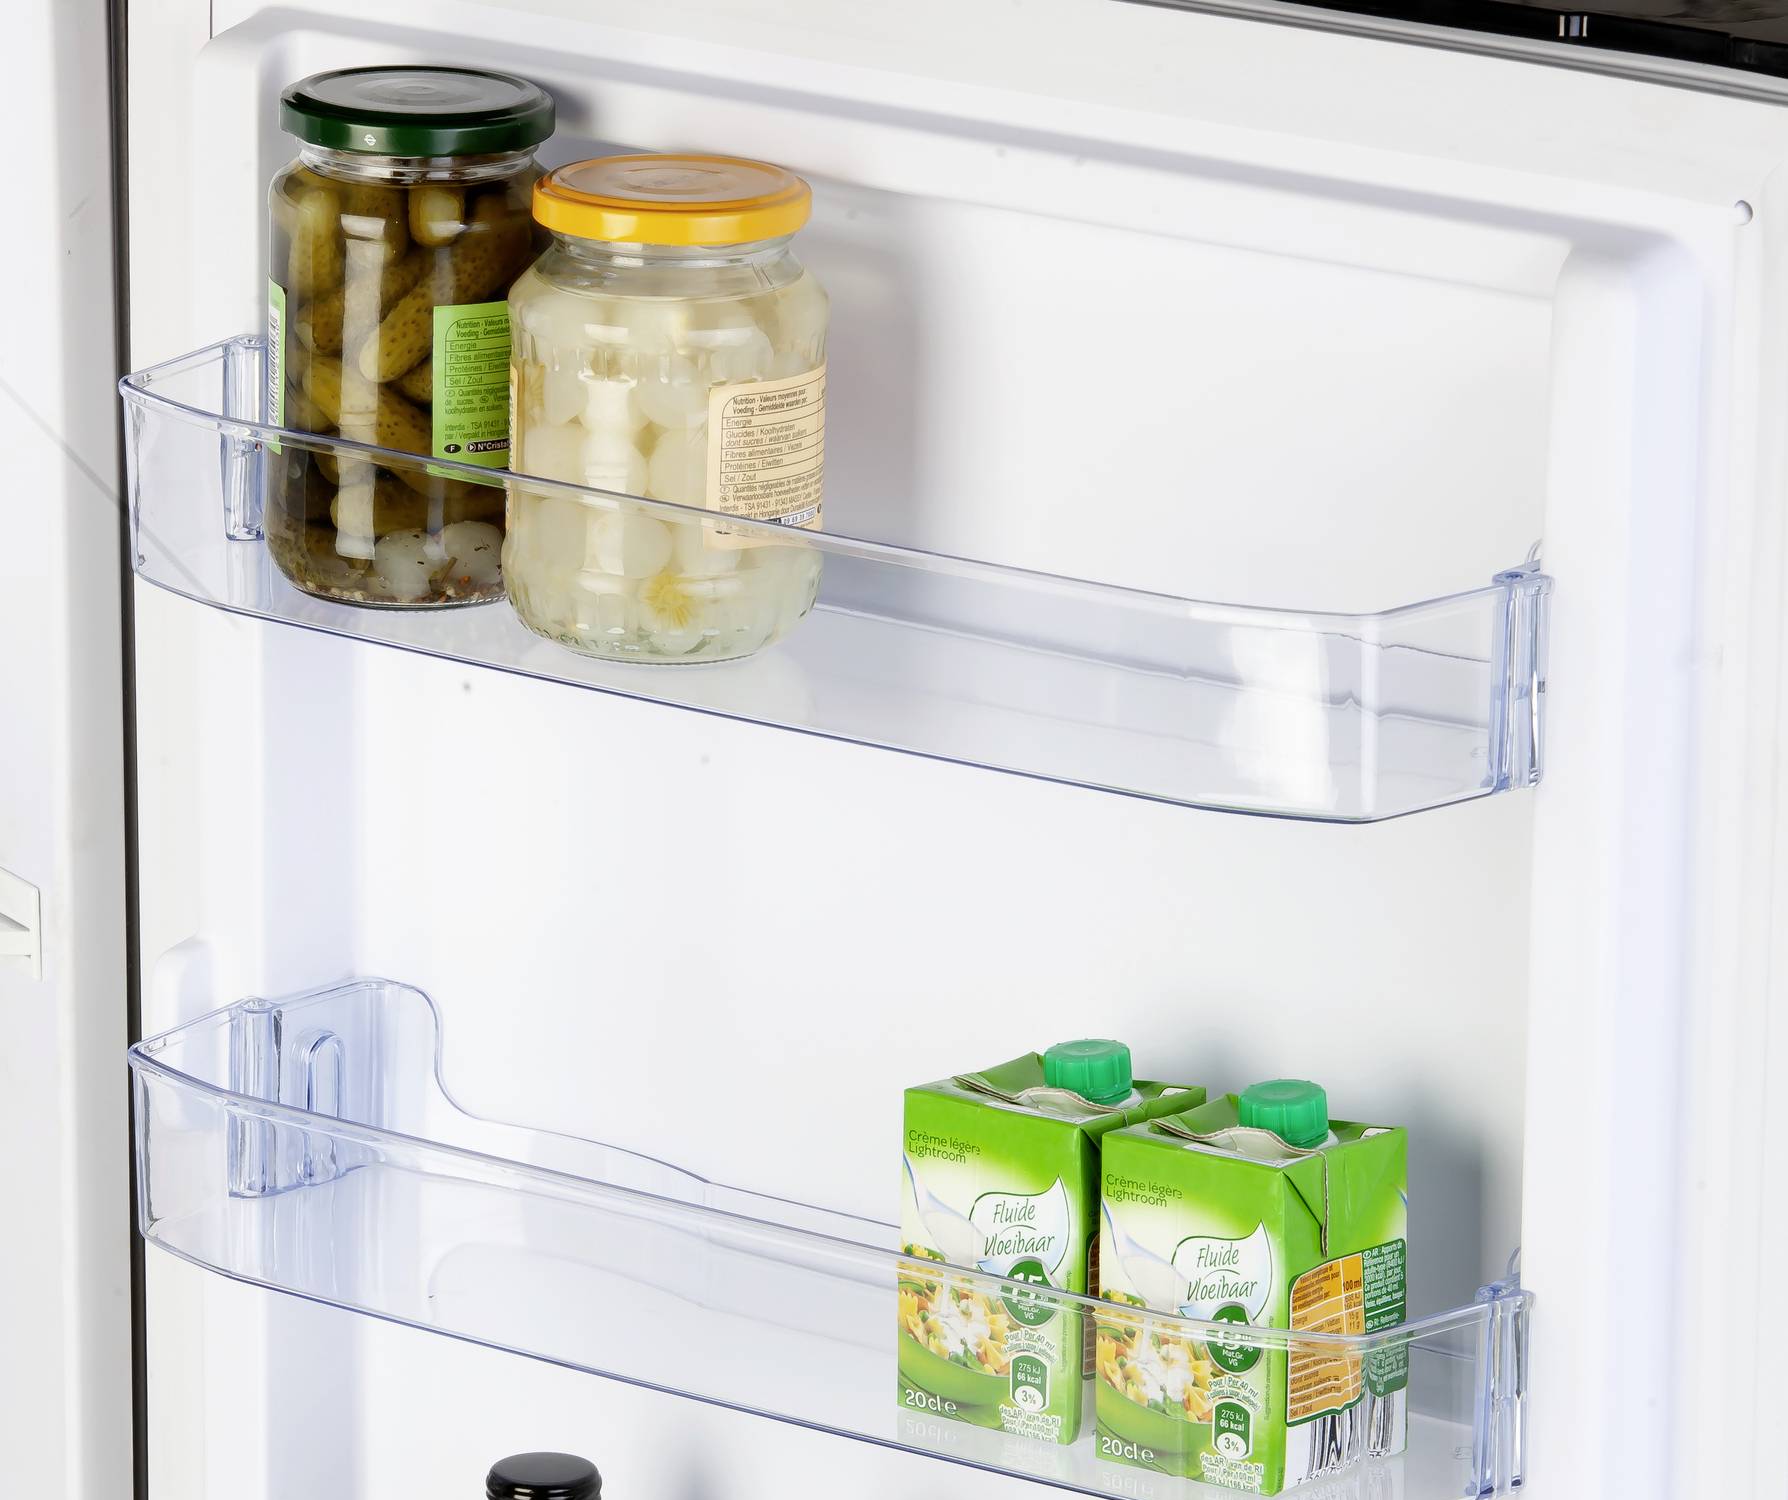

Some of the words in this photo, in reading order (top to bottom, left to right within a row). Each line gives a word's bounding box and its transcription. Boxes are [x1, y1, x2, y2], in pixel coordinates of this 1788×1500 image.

[456, 319, 480, 329] Nutrition
[449, 342, 477, 351] Energie
[449, 353, 472, 362] Fibres
[732, 396, 756, 405] Nutrition
[732, 405, 754, 415] Voeding
[726, 418, 752, 428] Energie
[725, 428, 755, 439] Glucides
[725, 439, 741, 447] dont
[742, 437, 763, 446] sucres
[725, 449, 747, 459] Fibres
[748, 445, 783, 457] alimentaires
[724, 460, 757, 471] Protéines
[761, 457, 784, 468] Eiwitten
[724, 473, 736, 483] Sel
[908, 1129, 947, 1147] Crème
[908, 1141, 966, 1164] Lightroom
[1106, 1173, 1146, 1191] Crème
[1106, 1185, 1167, 1208] Lightroom
[992, 1198, 1036, 1223] Fluide
[984, 1231, 1055, 1256] Vloeibaar
[1196, 1242, 1239, 1268] Fluide
[1187, 1275, 1257, 1301] Vloeibaar
[1023, 1311, 1034, 1320] VG
[1228, 1357, 1238, 1367] VG
[1027, 1374, 1041, 1385] kcal
[1209, 1379, 1223, 1389] Pour
[1228, 1377, 1239, 1387] Per
[1239, 1380, 1248, 1391] 40
[905, 1389, 941, 1412] 20cl
[1221, 1409, 1234, 1419] 275
[1219, 1419, 1229, 1428] 66
[1230, 1421, 1244, 1432] kcal
[1102, 1436, 1137, 1459] 20cl
